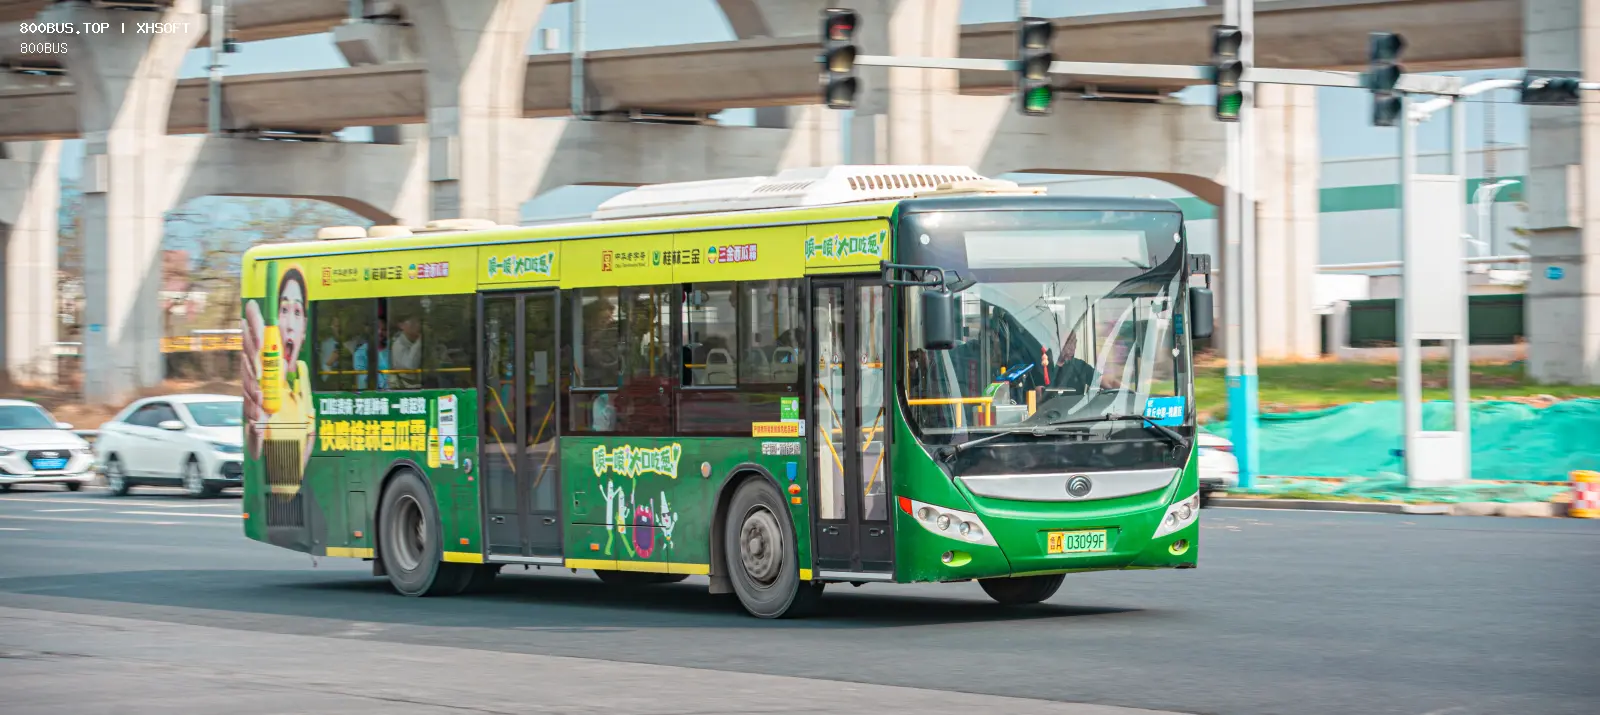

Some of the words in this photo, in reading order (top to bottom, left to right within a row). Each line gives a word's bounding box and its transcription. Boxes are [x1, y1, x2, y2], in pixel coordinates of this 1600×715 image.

[662, 248, 700, 266] 桂林三金
[718, 244, 758, 263] 三金西瓜霜
